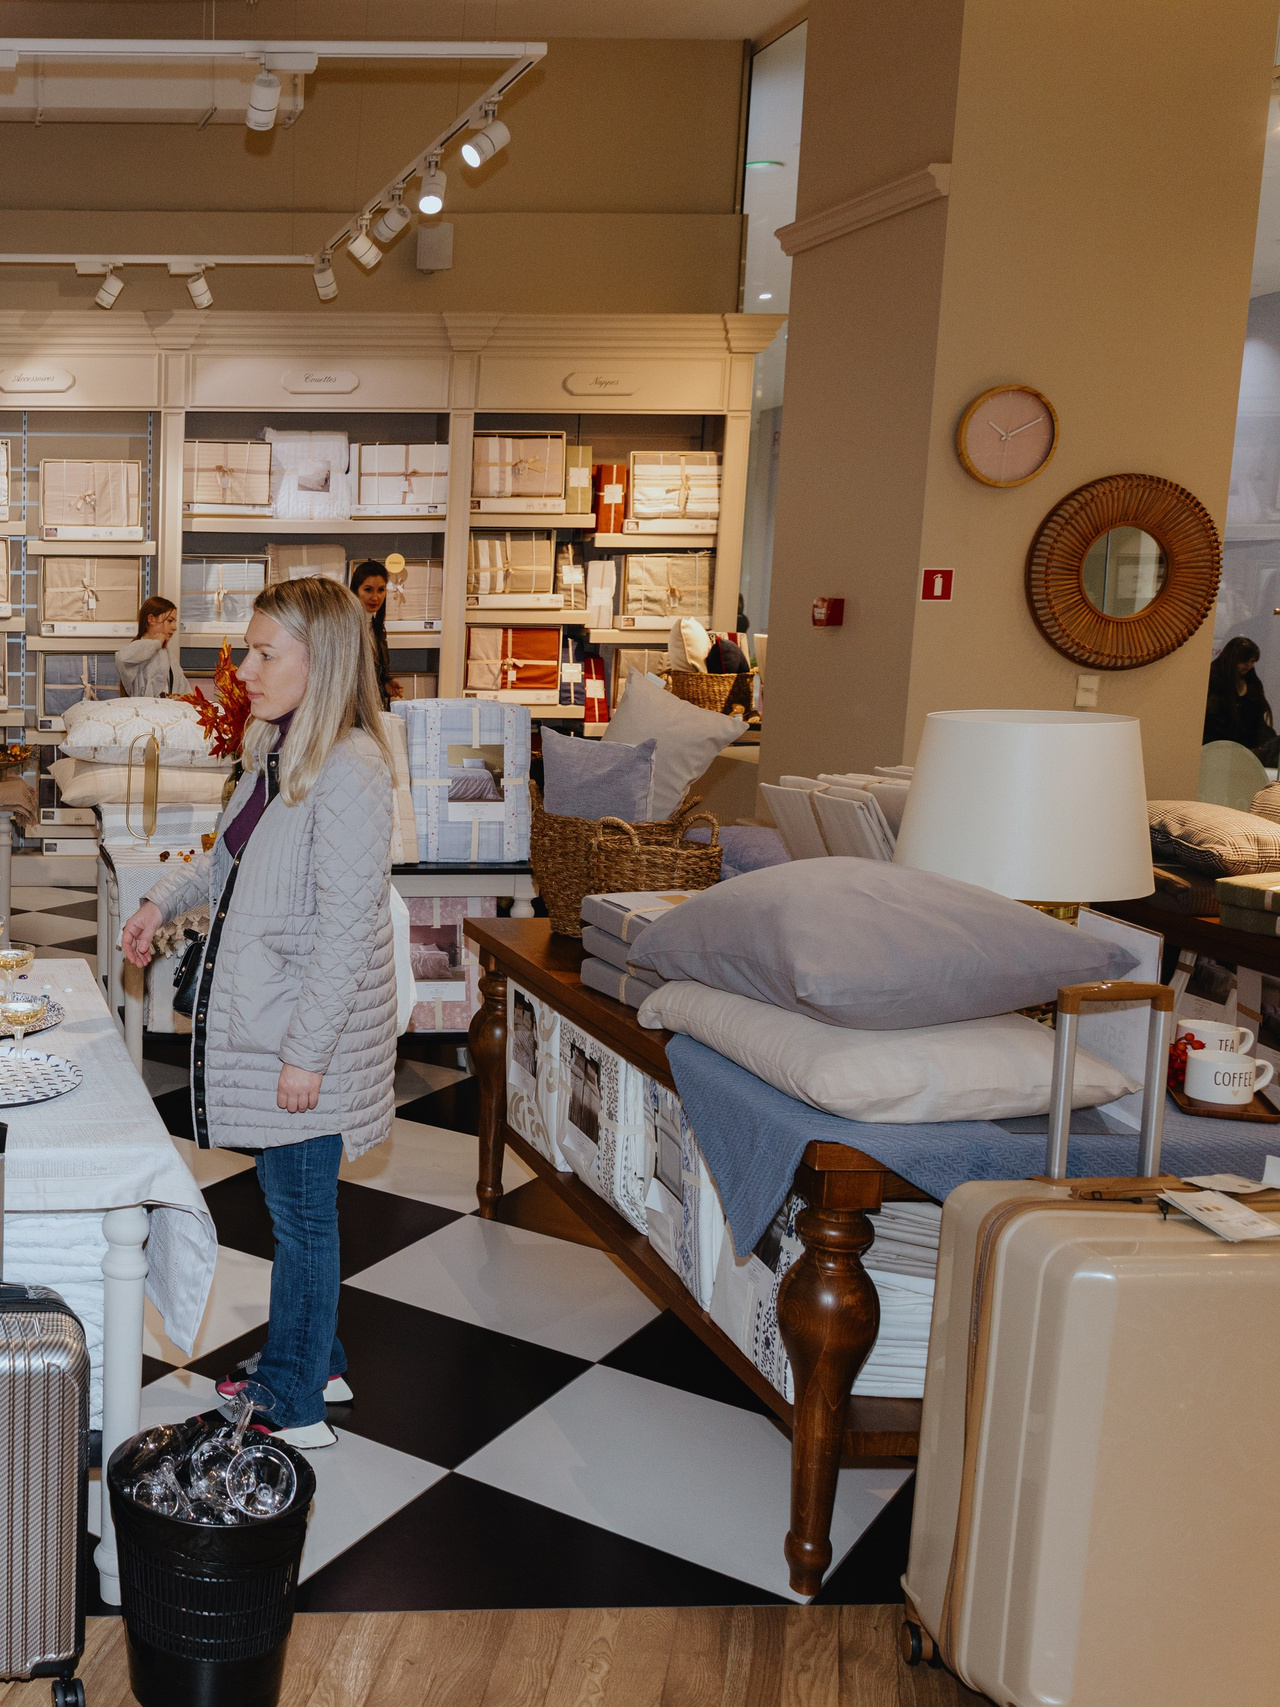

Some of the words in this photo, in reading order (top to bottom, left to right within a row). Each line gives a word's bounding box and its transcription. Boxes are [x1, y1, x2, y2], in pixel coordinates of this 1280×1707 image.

[12, 373, 55, 382] Accessoires
[304, 373, 337, 383] Couettes
[589, 376, 620, 389] Nappes
[1214, 1071, 1253, 1087] COFFEE
